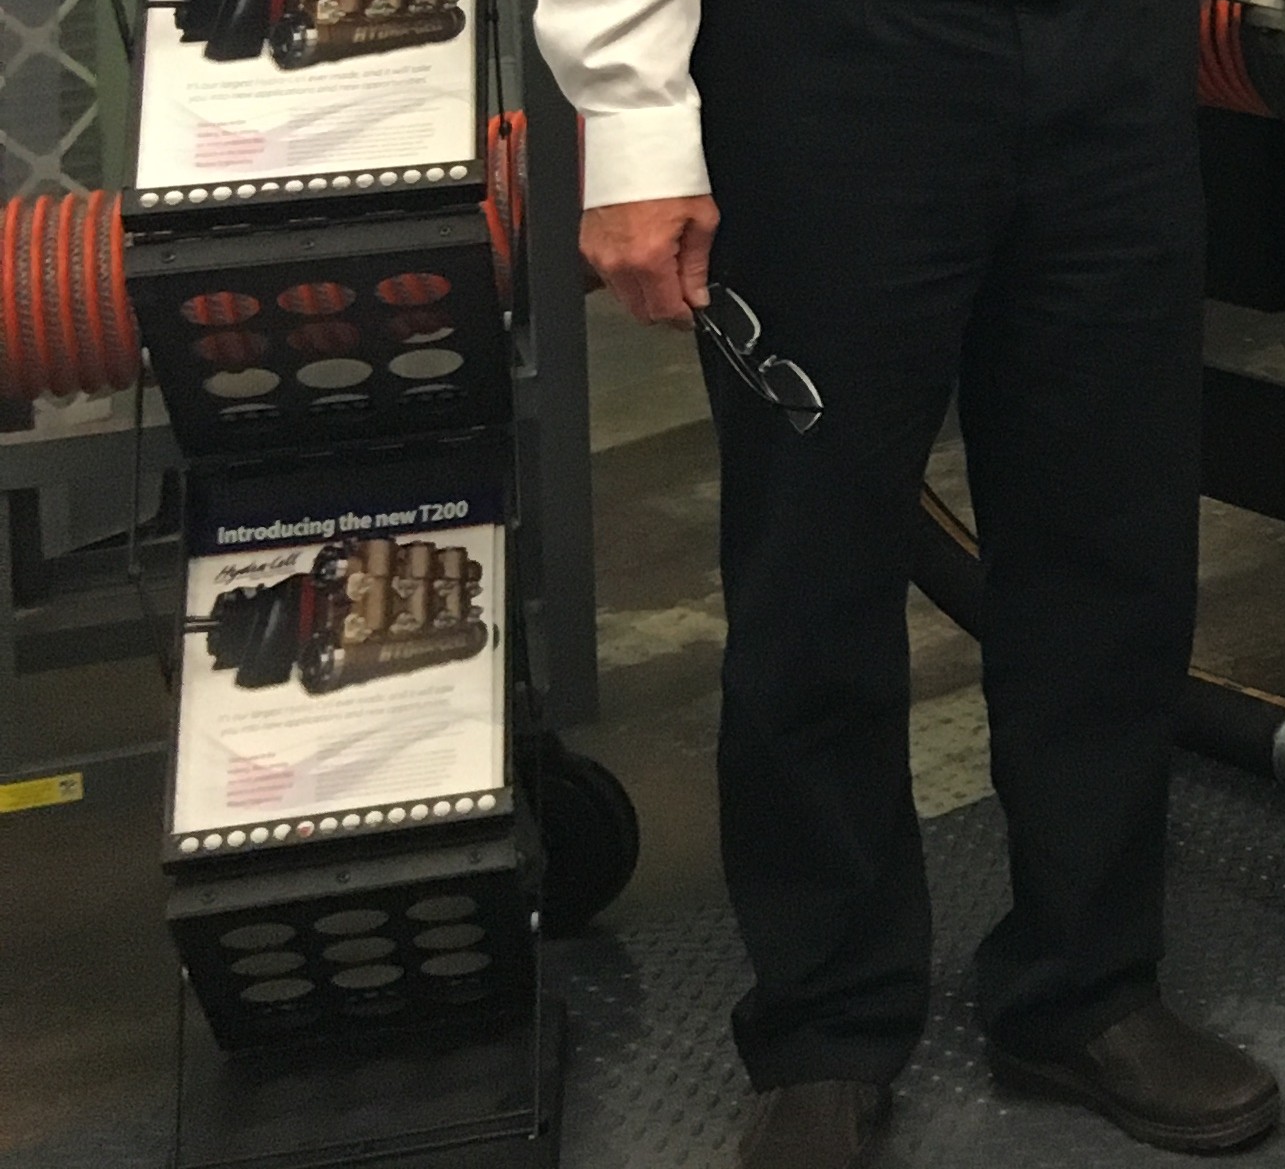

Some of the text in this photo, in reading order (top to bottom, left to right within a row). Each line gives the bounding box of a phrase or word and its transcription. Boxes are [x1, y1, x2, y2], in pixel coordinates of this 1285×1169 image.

[217, 500, 469, 545] Introducing the new T200
